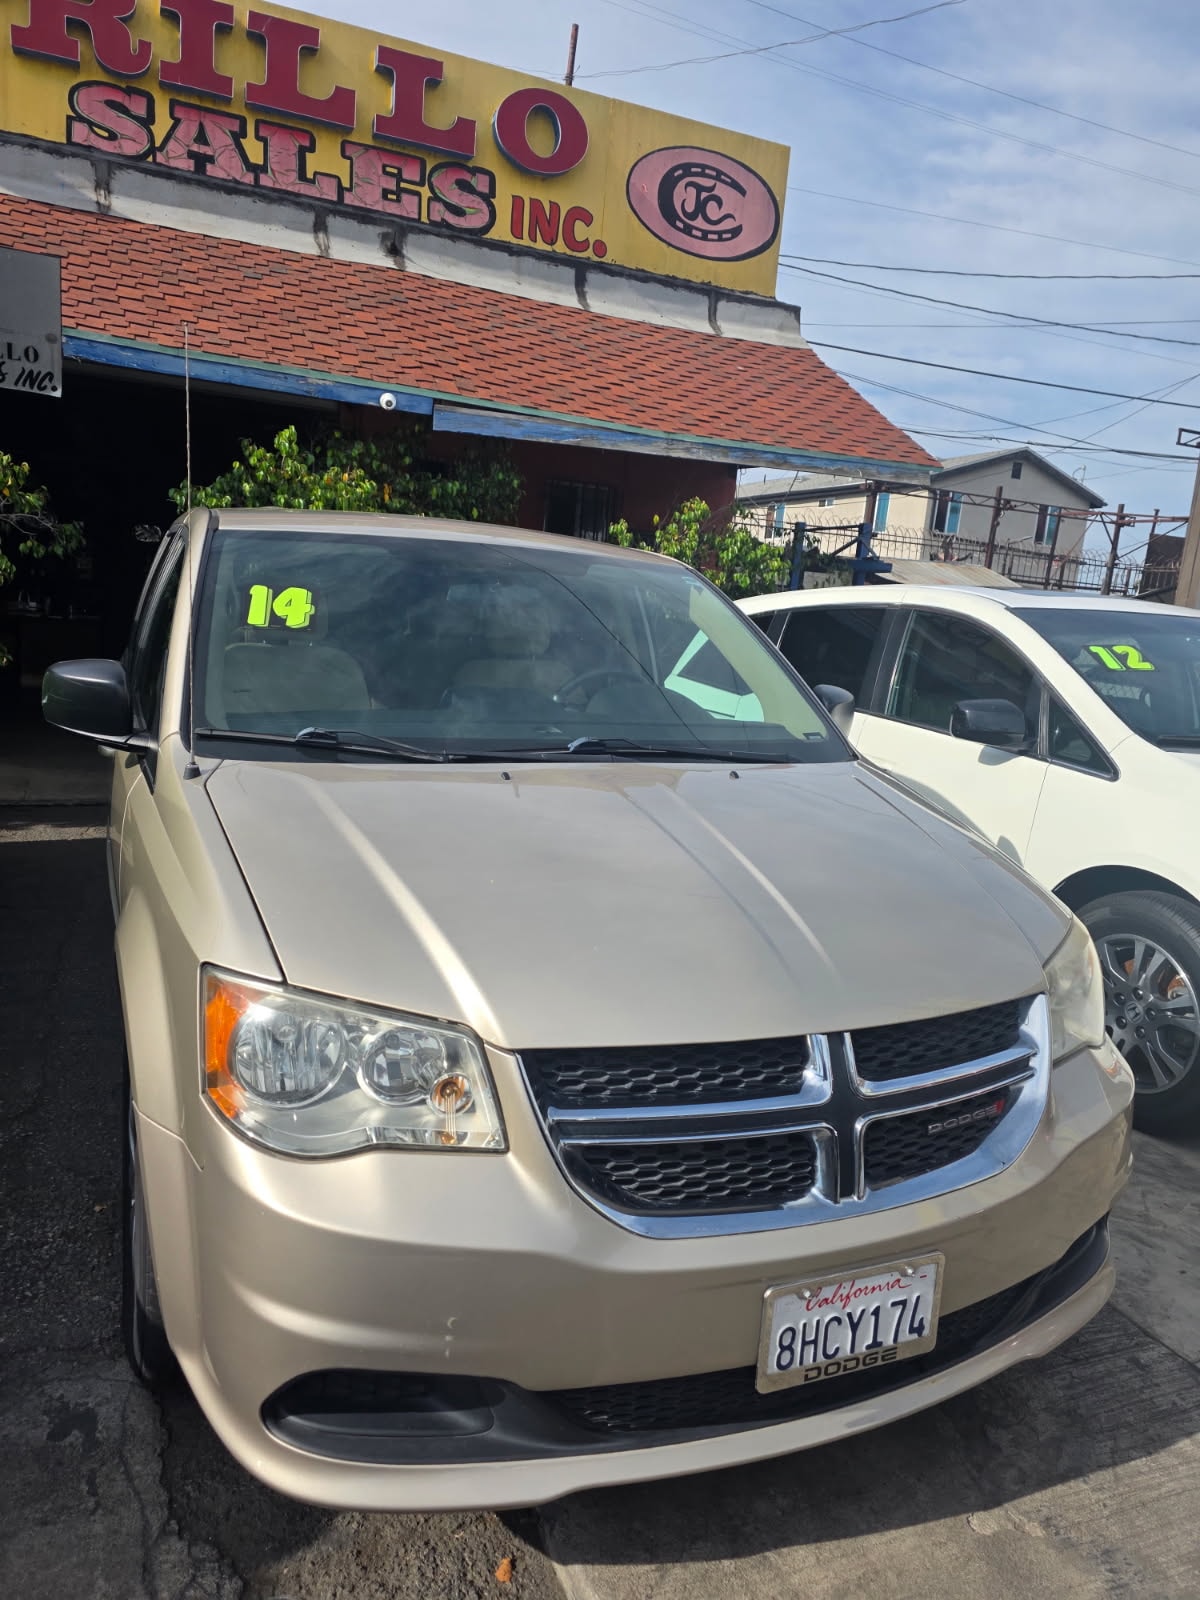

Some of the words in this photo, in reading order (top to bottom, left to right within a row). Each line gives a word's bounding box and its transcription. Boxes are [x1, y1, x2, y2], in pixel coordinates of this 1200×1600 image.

[66, 80, 497, 237] SALES
[510, 193, 608, 259] INC.
[14, 366, 58, 392] INC.
[247, 584, 316, 629] 14
[1088, 645, 1155, 671] 12
[927, 1103, 999, 1136] DODGE
[805, 1275, 913, 1312] California
[775, 1293, 926, 1372] 8HCY174
[803, 1346, 899, 1383] DODGE
